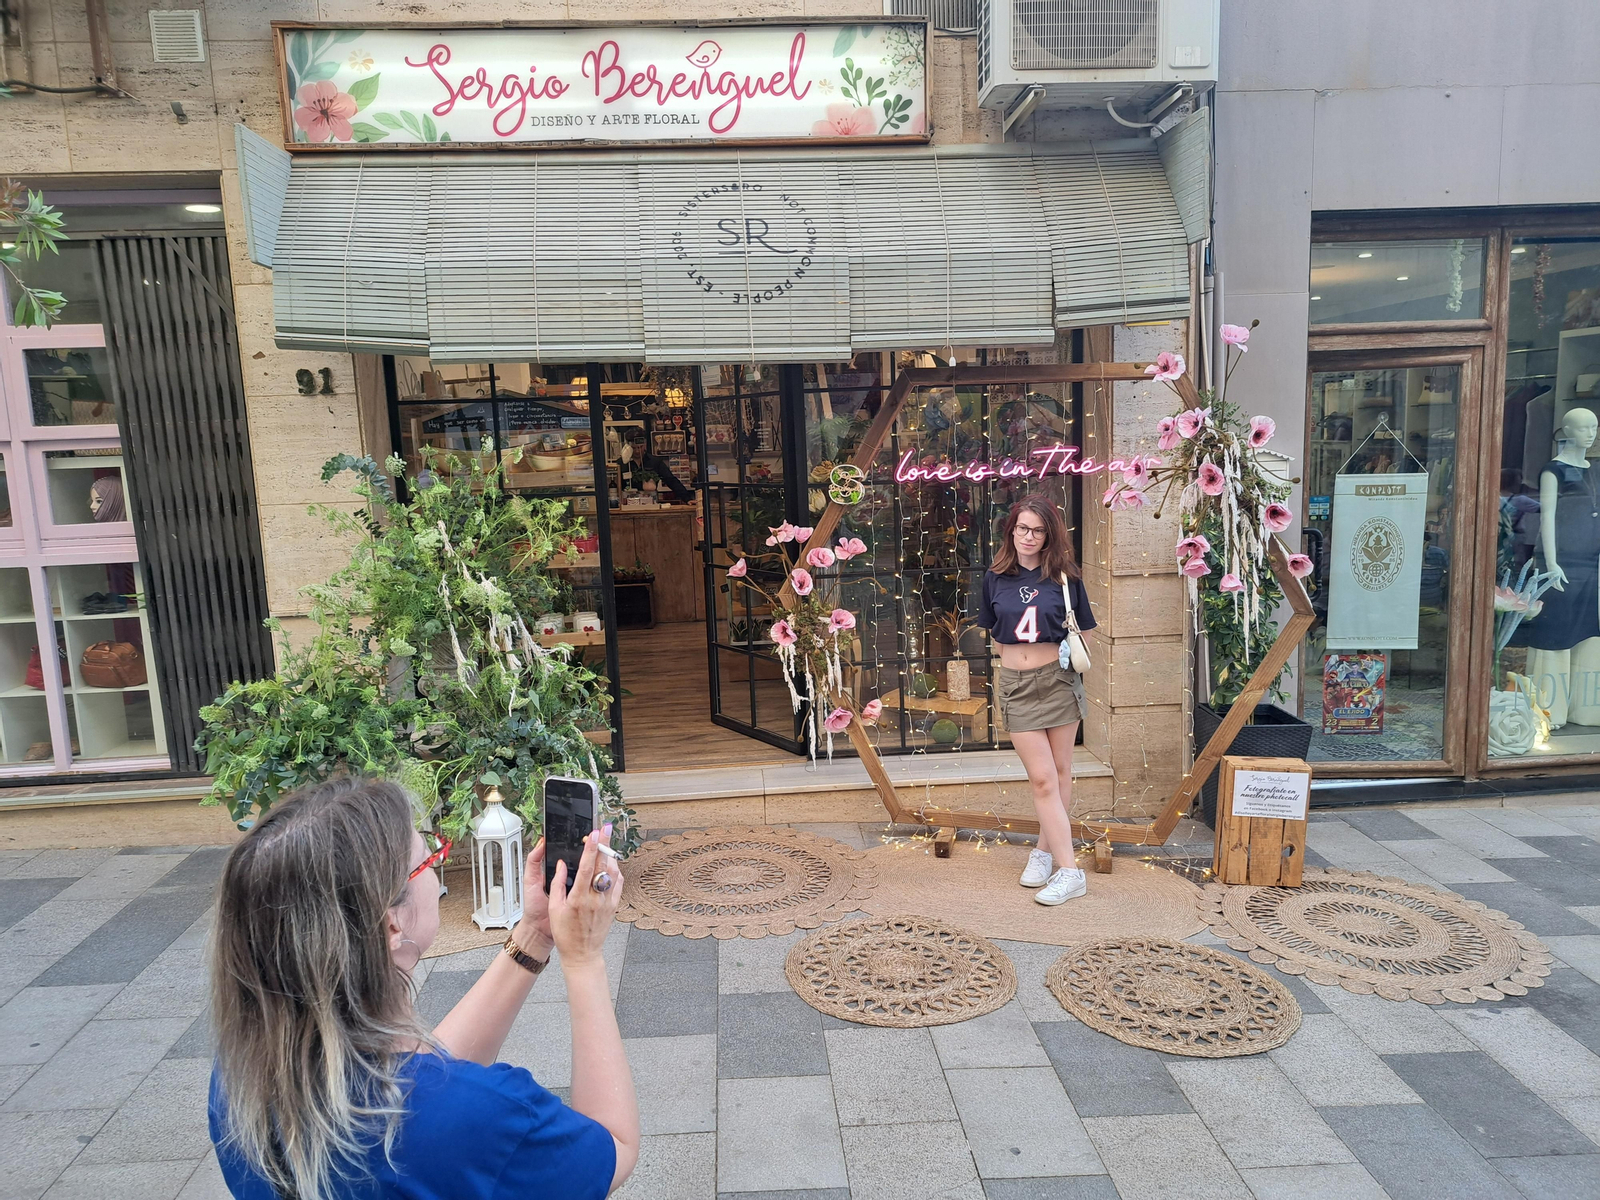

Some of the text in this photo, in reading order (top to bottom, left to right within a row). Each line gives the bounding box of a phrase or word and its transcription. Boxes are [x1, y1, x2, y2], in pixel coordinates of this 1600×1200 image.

[404, 31, 813, 137] Sergio Berenguel
[531, 113, 700, 127] DISEÑO Y ARTE FLORAL
[732, 193, 818, 304] NOT COMMON PEOPLE
[295, 366, 334, 395] 91
[895, 448, 963, 483] love
[964, 458, 996, 482] is
[999, 458, 1033, 478] in
[1359, 485, 1402, 495] KONPLOTT
[1013, 605, 1041, 643] 4
[1325, 718, 1338, 726] 23
[1371, 717, 1379, 726] 2
[1263, 791, 1300, 802] photocall
